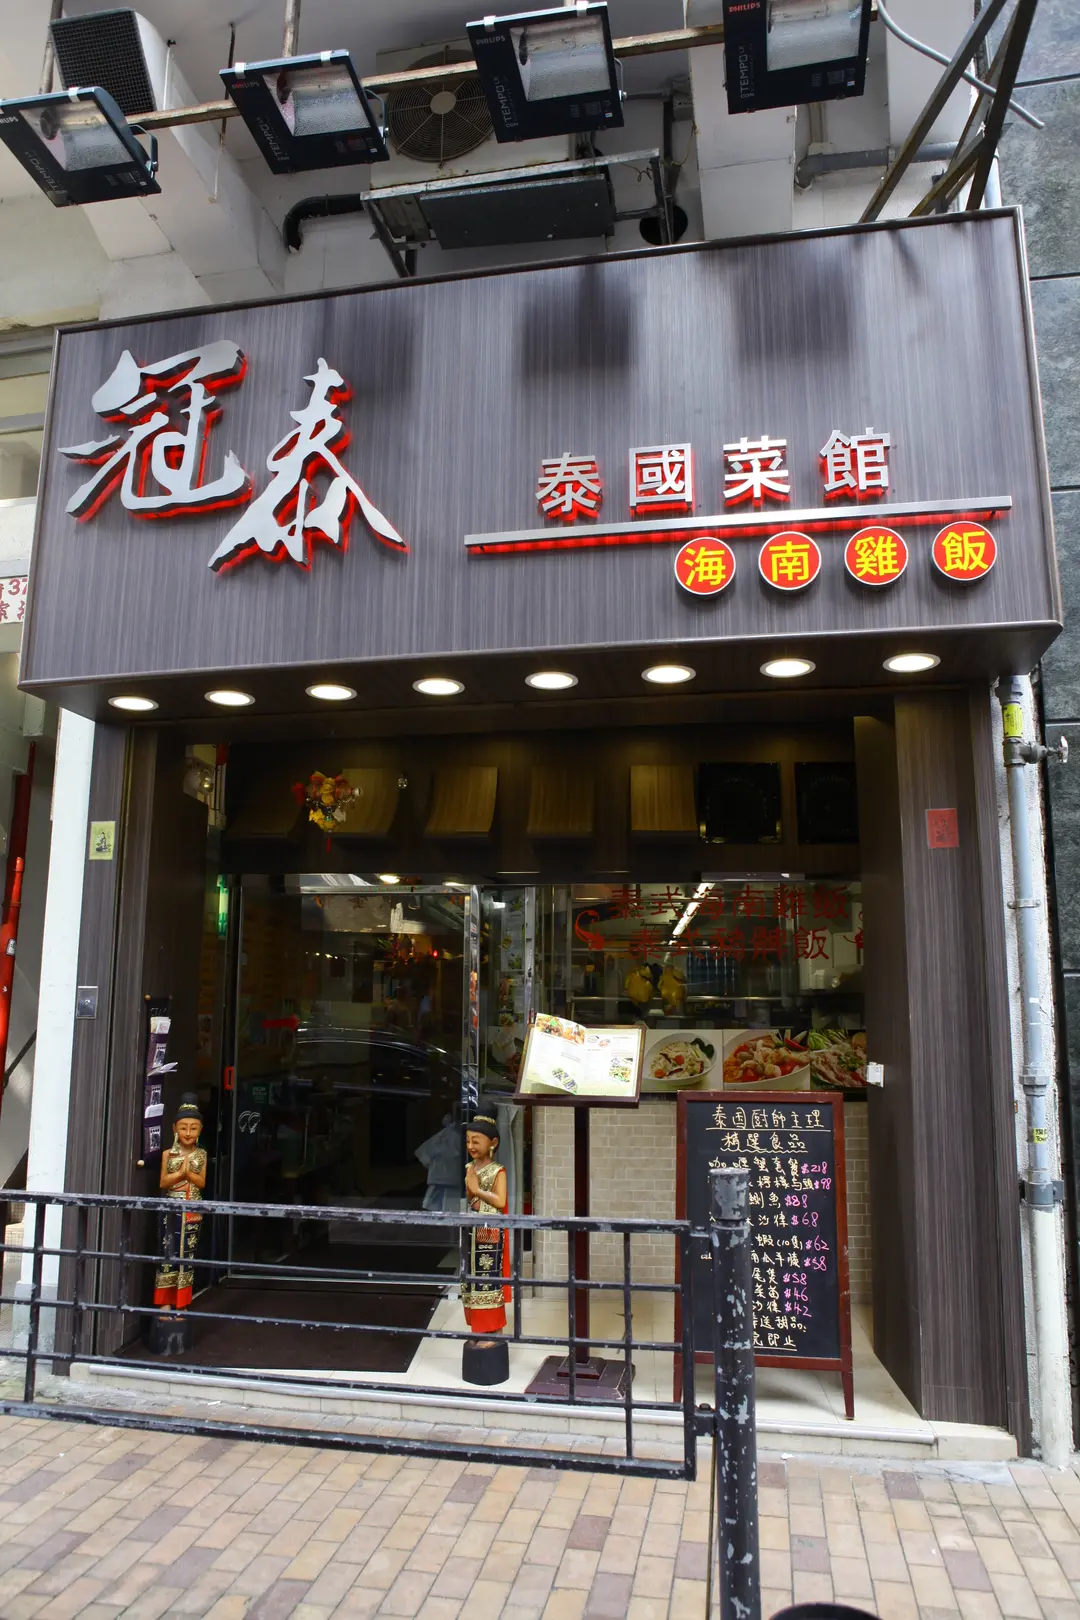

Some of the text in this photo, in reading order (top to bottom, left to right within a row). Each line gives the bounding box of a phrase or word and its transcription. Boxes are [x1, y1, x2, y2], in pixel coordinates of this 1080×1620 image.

[728, 2, 761, 13] PHILIPS
[475, 35, 506, 45] PHILIPS
[534, 427, 891, 514] 泰國菜館
[685, 529, 990, 587] 海南雞飯
[608, 885, 850, 920] 泰式海南雞飯
[800, 1161, 829, 1175] $218
[784, 1194, 808, 1208] $88
[790, 1211, 819, 1227] $68
[805, 1235, 830, 1251] $62
[803, 1255, 827, 1271] $58
[782, 1272, 807, 1285] $58
[783, 1287, 809, 1301] $46
[783, 1301, 812, 1317] $42
